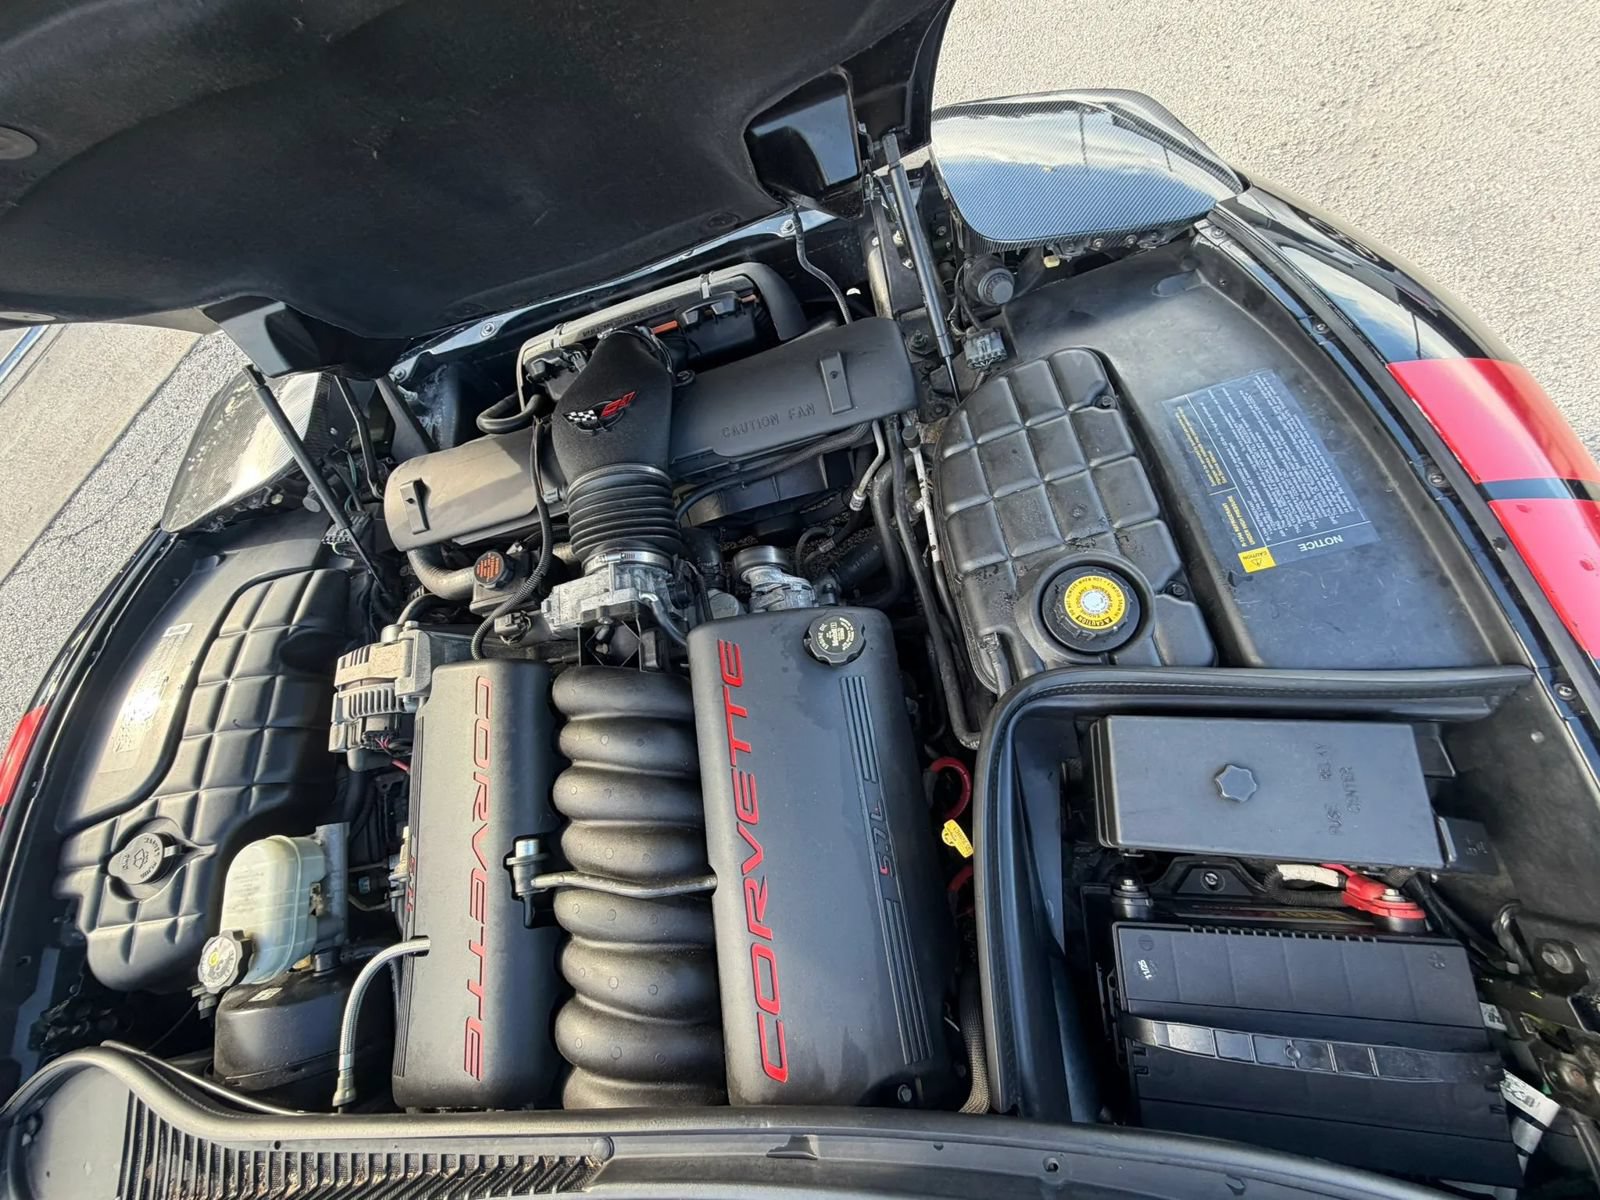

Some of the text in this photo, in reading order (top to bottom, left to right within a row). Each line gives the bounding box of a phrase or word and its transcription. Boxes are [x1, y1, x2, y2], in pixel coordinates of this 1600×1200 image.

[721, 402, 816, 438] CAUTION FAN
[1298, 534, 1344, 552] NOTICE
[1078, 616, 1105, 626] CAUTION
[463, 675, 492, 1082] CORVETTE
[717, 639, 789, 1083] CORVETTE
